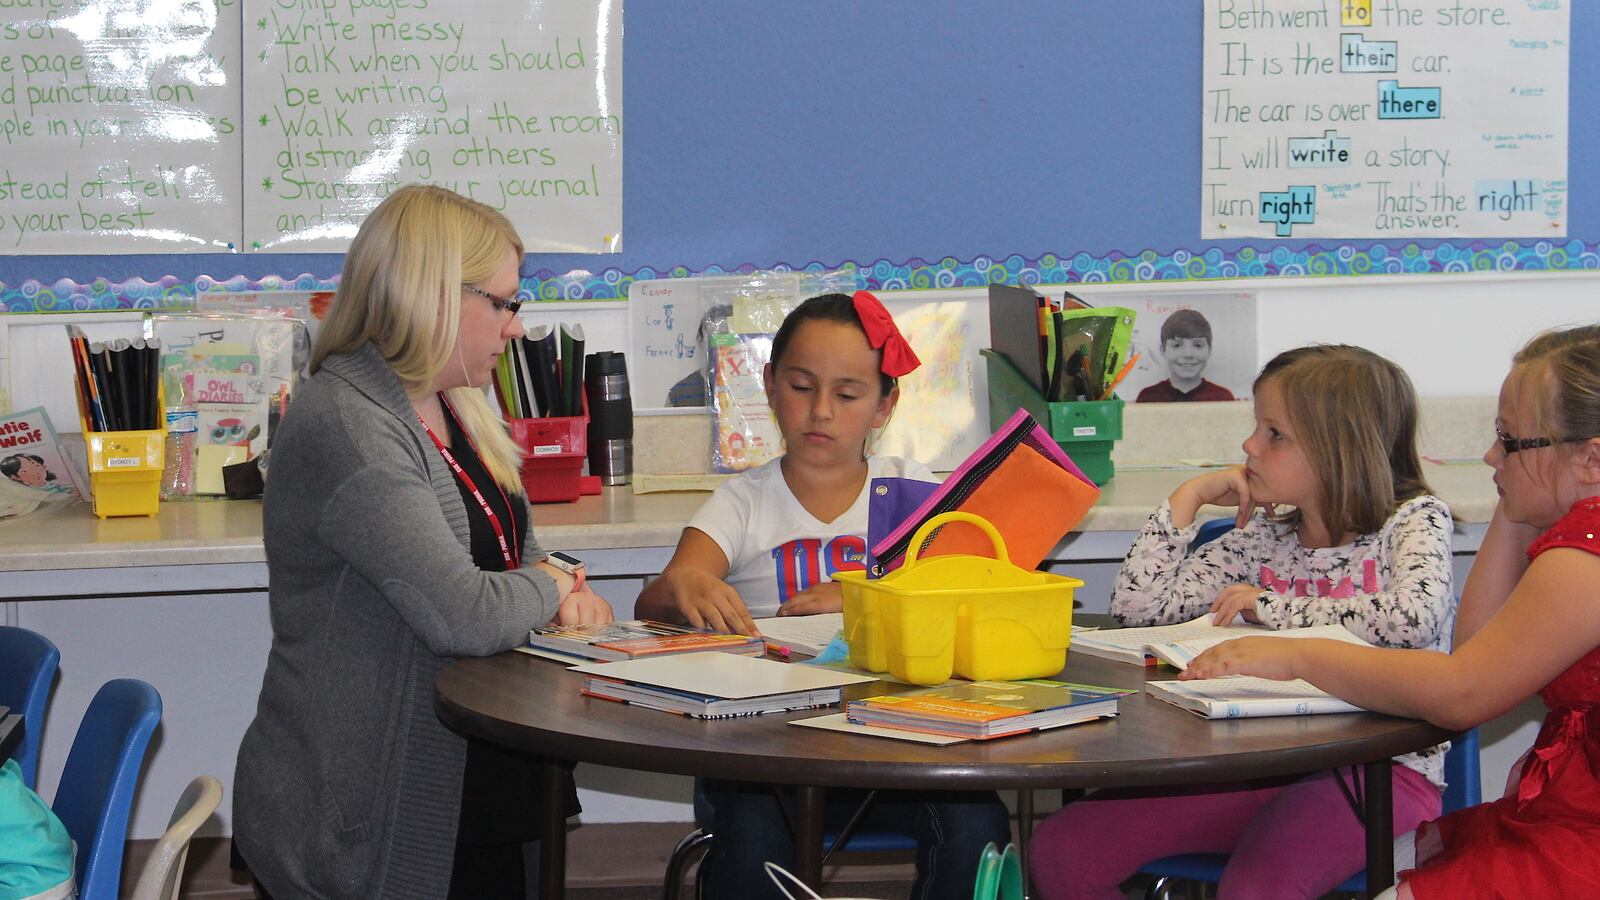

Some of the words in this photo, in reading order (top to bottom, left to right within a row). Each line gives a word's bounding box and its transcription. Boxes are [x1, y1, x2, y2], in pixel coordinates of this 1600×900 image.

[272, 9, 358, 42] Write
[371, 22, 464, 54] messy
[1219, 0, 1275, 29] Beth
[1279, 0, 1328, 28] went
[1344, 0, 1367, 20] to
[1379, 0, 1424, 27] the
[1437, 0, 1511, 27] store.
[21, 54, 85, 81] page
[275, 41, 341, 74] Talk
[349, 42, 420, 73] when
[430, 54, 478, 84] you
[489, 37, 585, 71] should
[1219, 42, 1254, 76] It
[1262, 52, 1284, 75] is
[1290, 42, 1336, 75] the
[1345, 43, 1395, 66] their
[1412, 55, 1451, 73] car.
[27, 73, 194, 117] punctuaion
[281, 73, 322, 107] be
[335, 75, 448, 113] writing
[1208, 88, 1251, 123] The
[1259, 104, 1295, 122] car
[1305, 104, 1323, 121] is
[1328, 103, 1371, 121] over
[47, 113, 68, 136] in
[274, 105, 353, 137] Walk
[368, 104, 469, 135] arund
[488, 101, 542, 134] the
[550, 115, 621, 135] room
[452, 136, 556, 166] others
[1208, 136, 1231, 170] I
[1241, 136, 1279, 169] will
[1291, 139, 1349, 162] write
[1364, 150, 1381, 167] a
[1389, 136, 1451, 178] story.
[81, 168, 112, 198] of
[278, 169, 359, 200] Stare
[496, 165, 600, 211] journal
[1204, 183, 1254, 216] Turn
[1430, 181, 1467, 212] the
[1479, 180, 1539, 221] right
[13, 214, 70, 247] your
[78, 200, 156, 231] best
[1375, 214, 1460, 230] answer.
[198, 390, 245, 403] DIARIES
[207, 380, 237, 391] OWL
[0, 429, 42, 448] Wolf
